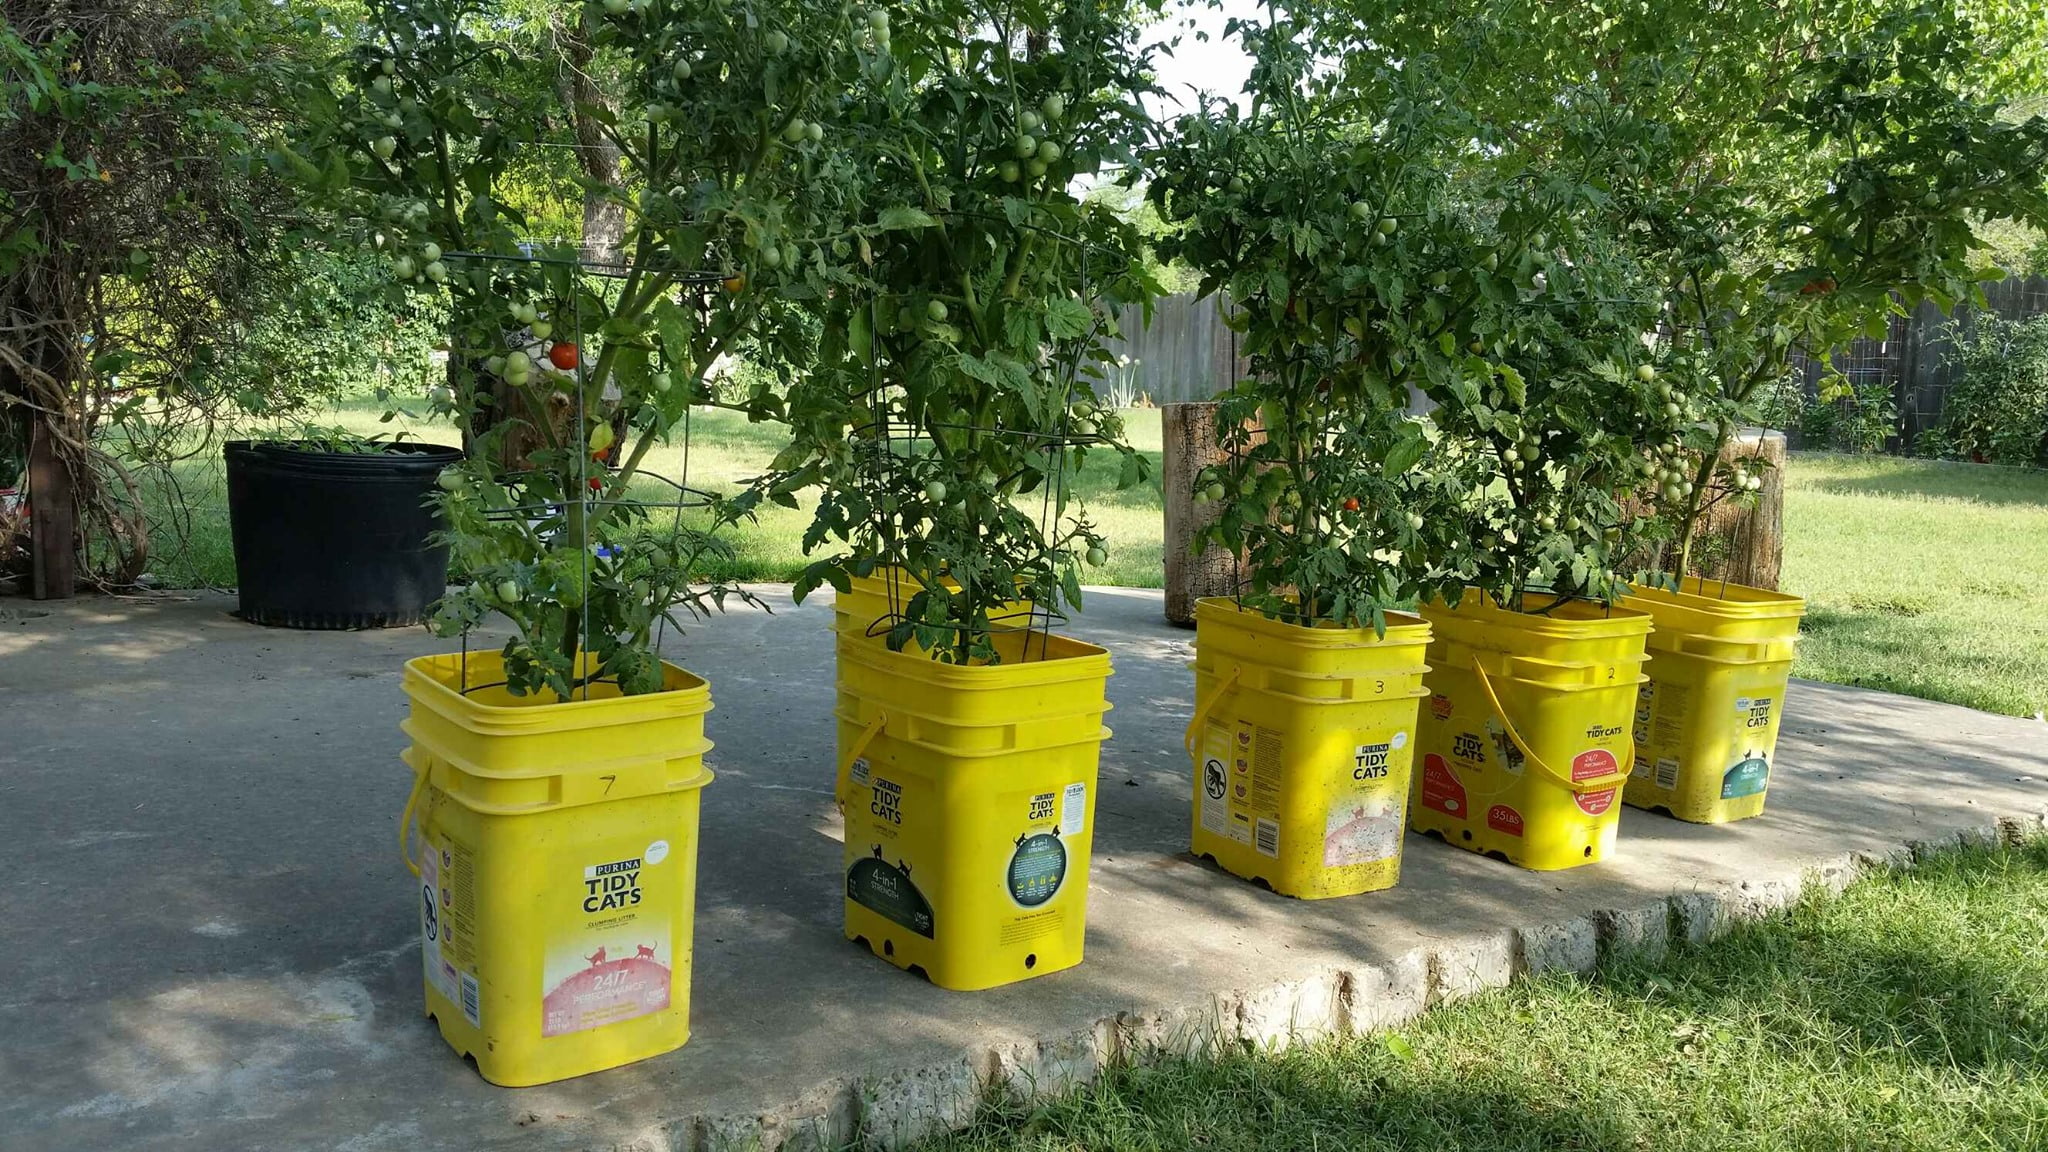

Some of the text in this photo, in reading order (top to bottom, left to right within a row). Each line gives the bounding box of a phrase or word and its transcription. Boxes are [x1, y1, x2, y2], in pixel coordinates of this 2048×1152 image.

[1608, 667, 1615, 679] 2
[1375, 680, 1385, 694] 3
[1750, 706, 1770, 717] TIDY
[1747, 717, 1768, 728] CATS
[1586, 729, 1604, 739] TIDY
[1605, 727, 1622, 736] CATS
[1363, 743, 1388, 753] PURINA
[1454, 736, 1484, 752] TIDY
[1355, 753, 1388, 767] TIDY
[1453, 747, 1485, 763] CATS
[1353, 765, 1388, 780] CATS
[599, 774, 616, 795] 7
[872, 787, 901, 808] TIDY
[1031, 799, 1054, 811] TIDY
[871, 802, 902, 825] CATS
[1029, 808, 1054, 820] CATS
[597, 859, 641, 876] PURINA
[585, 871, 640, 896] TIDY
[872, 869, 897, 890] 4-in-1
[871, 880, 900, 900] STRENGTH
[583, 888, 641, 912] CATS
[618, 913, 636, 922] LITTER
[594, 969, 629, 991] 24/7
